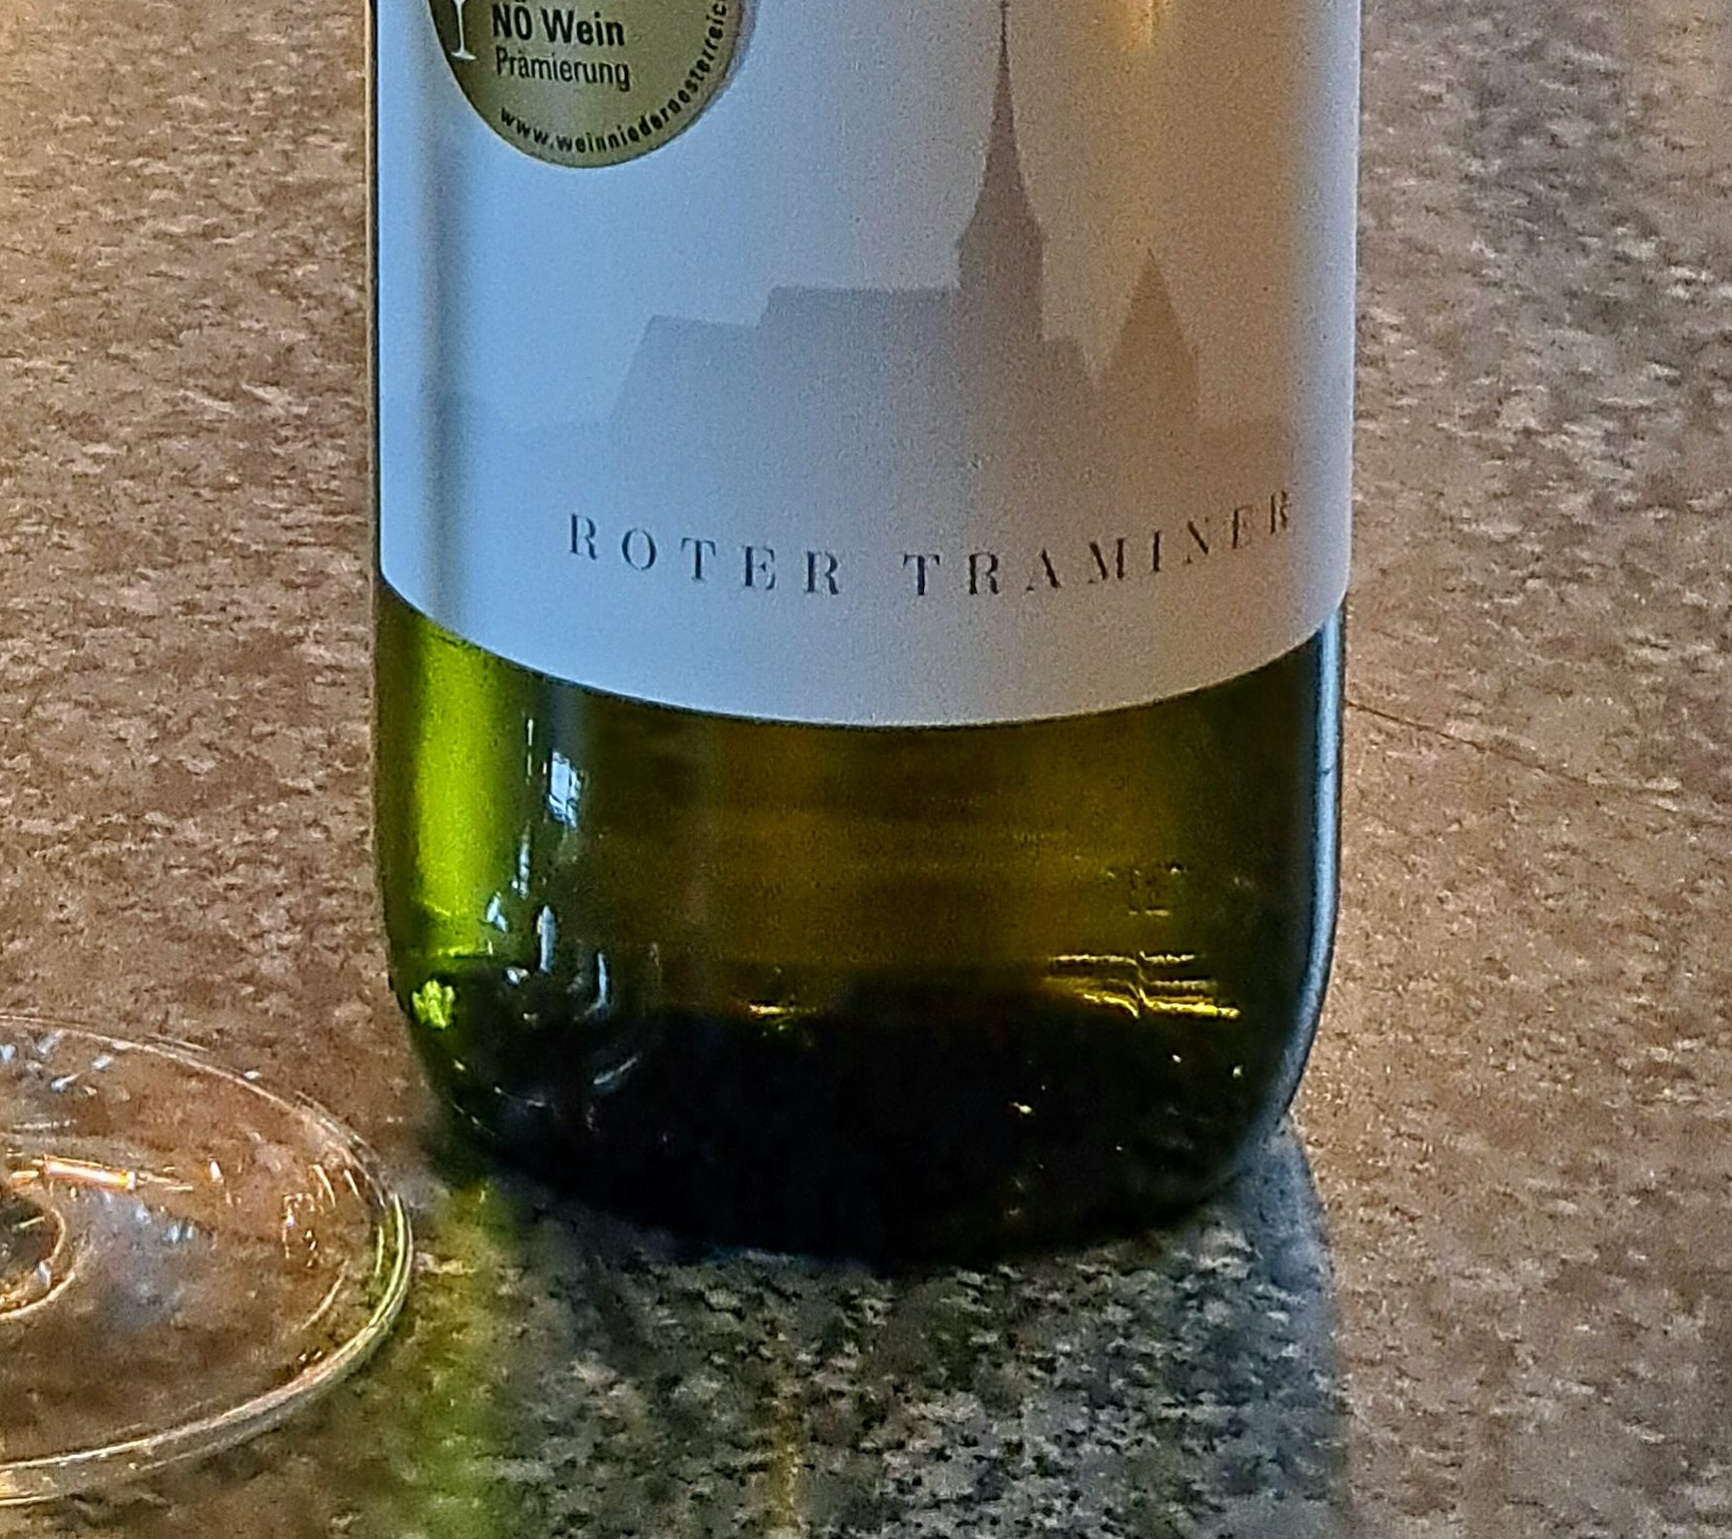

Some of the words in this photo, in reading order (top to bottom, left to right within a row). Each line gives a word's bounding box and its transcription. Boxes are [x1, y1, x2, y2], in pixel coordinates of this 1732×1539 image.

[540, 6, 625, 46] Wein
[495, 45, 630, 92] Prämierung
[569, 513, 841, 597] ROTER
[903, 489, 1293, 598] TRAMINER
